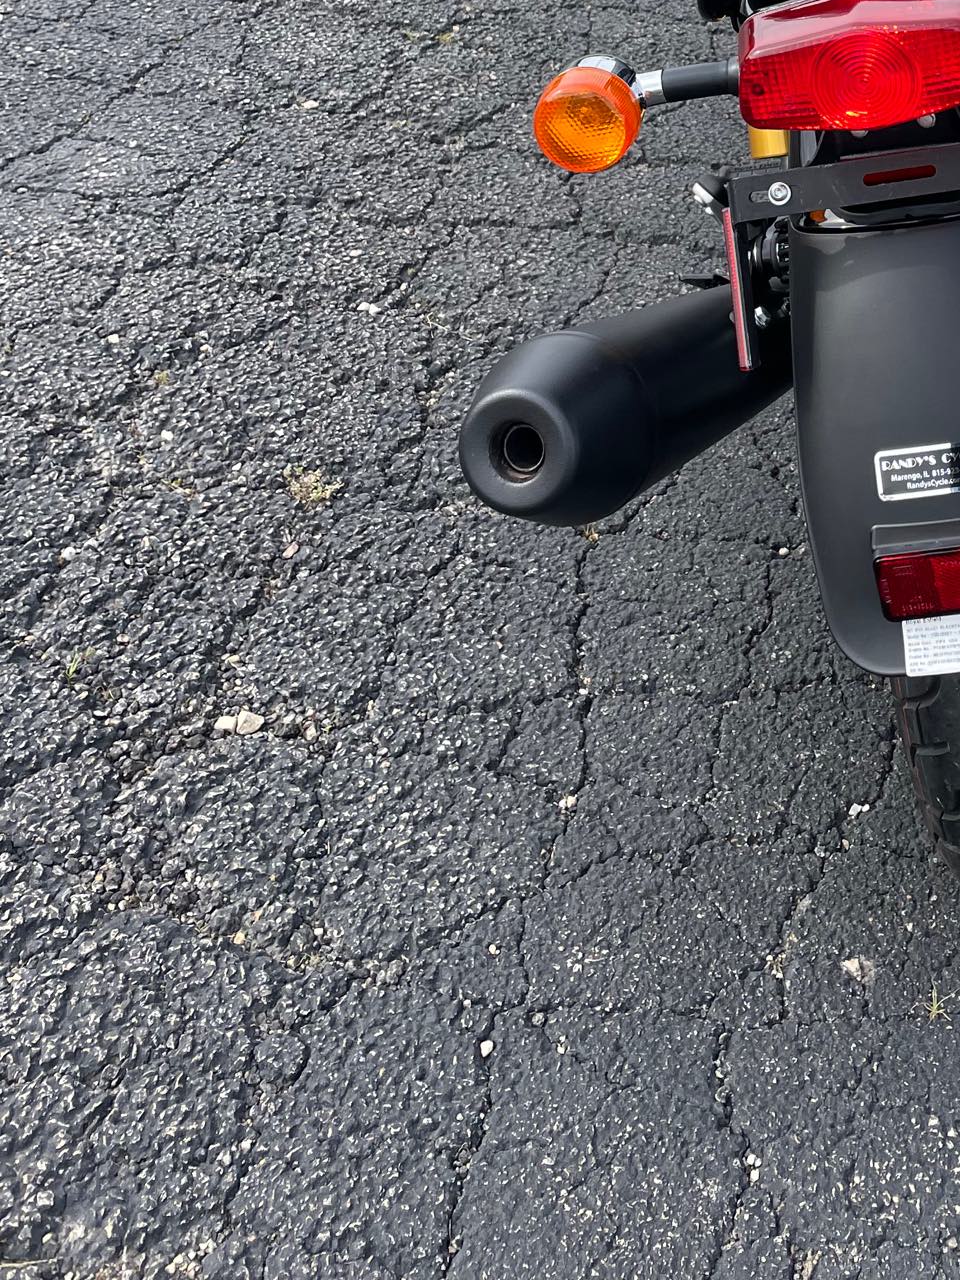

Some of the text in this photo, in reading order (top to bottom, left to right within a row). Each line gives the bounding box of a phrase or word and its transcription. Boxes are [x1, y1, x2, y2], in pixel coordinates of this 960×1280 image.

[881, 454, 937, 471] RANDY'S
[891, 473, 922, 482] Marengo,
[923, 470, 930, 478] IL
